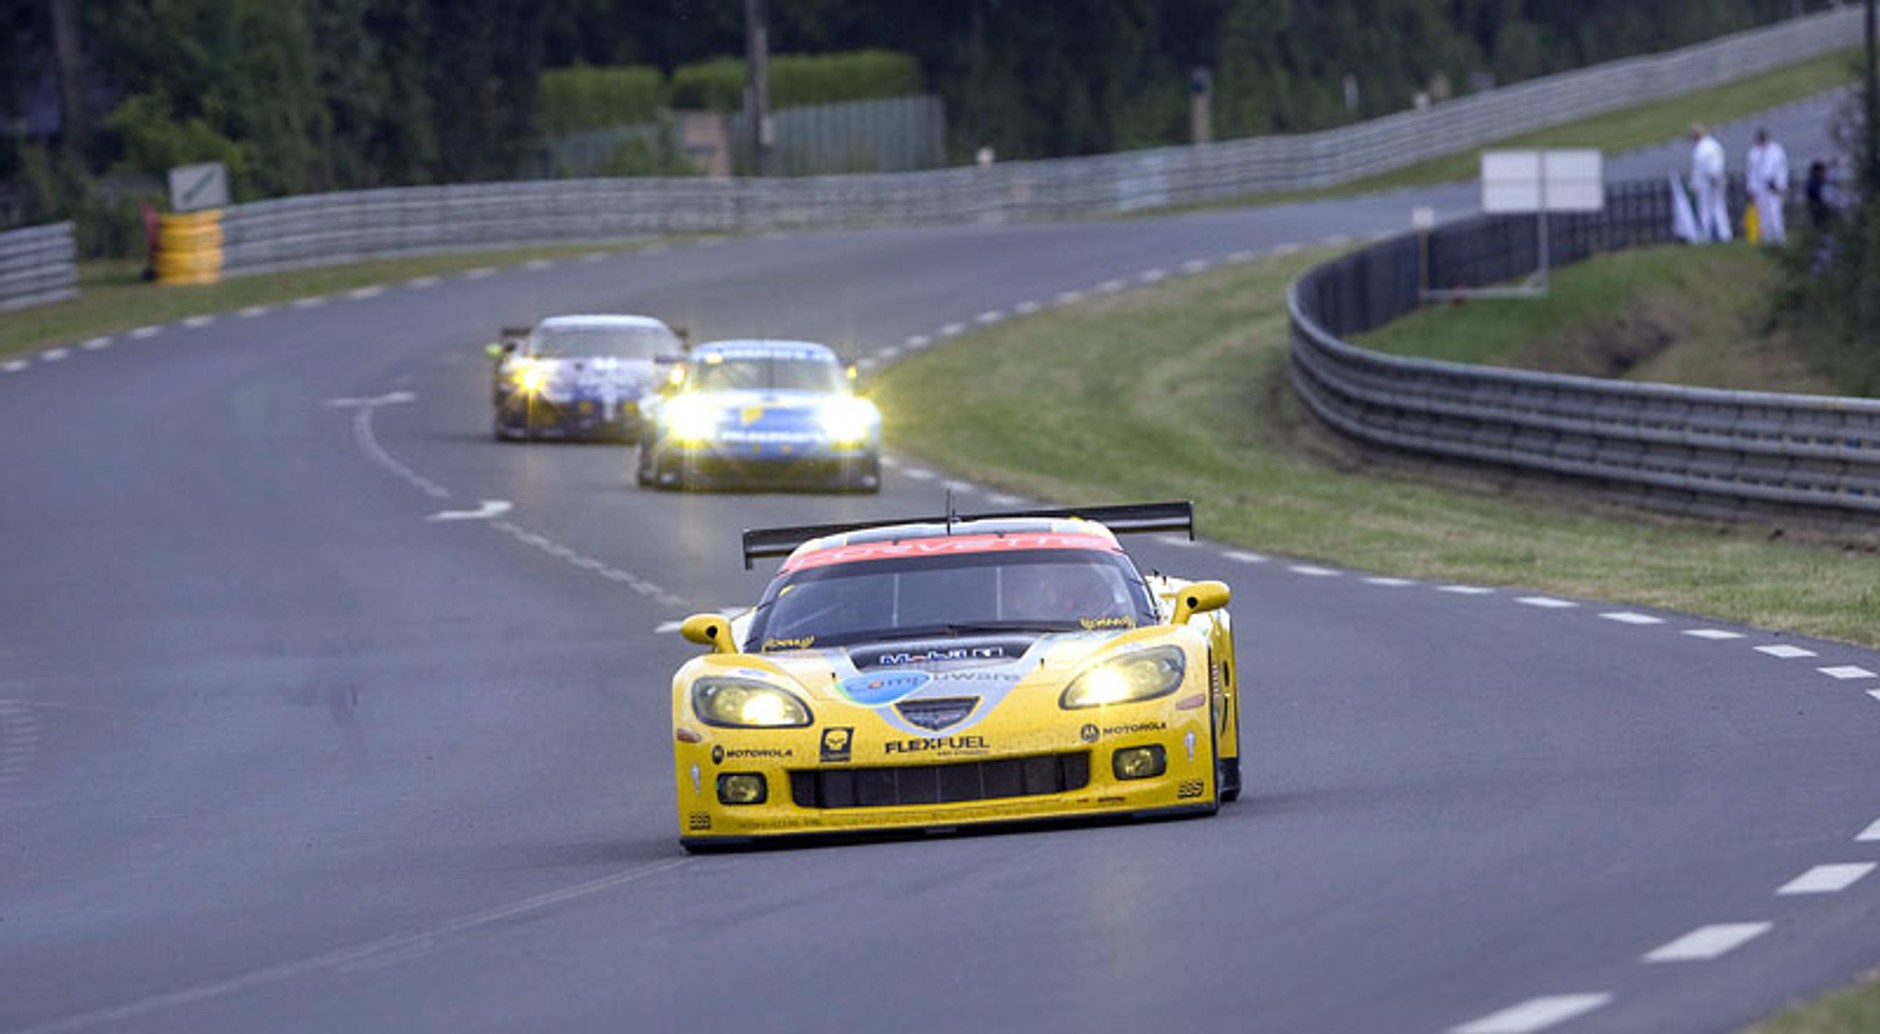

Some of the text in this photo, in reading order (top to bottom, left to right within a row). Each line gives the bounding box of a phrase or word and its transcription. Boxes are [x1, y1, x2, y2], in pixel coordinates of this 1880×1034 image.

[1102, 721, 1168, 735] MOTOROLA
[884, 736, 990, 754] FLEXFUEL
[725, 749, 793, 758] MOTOROLA
